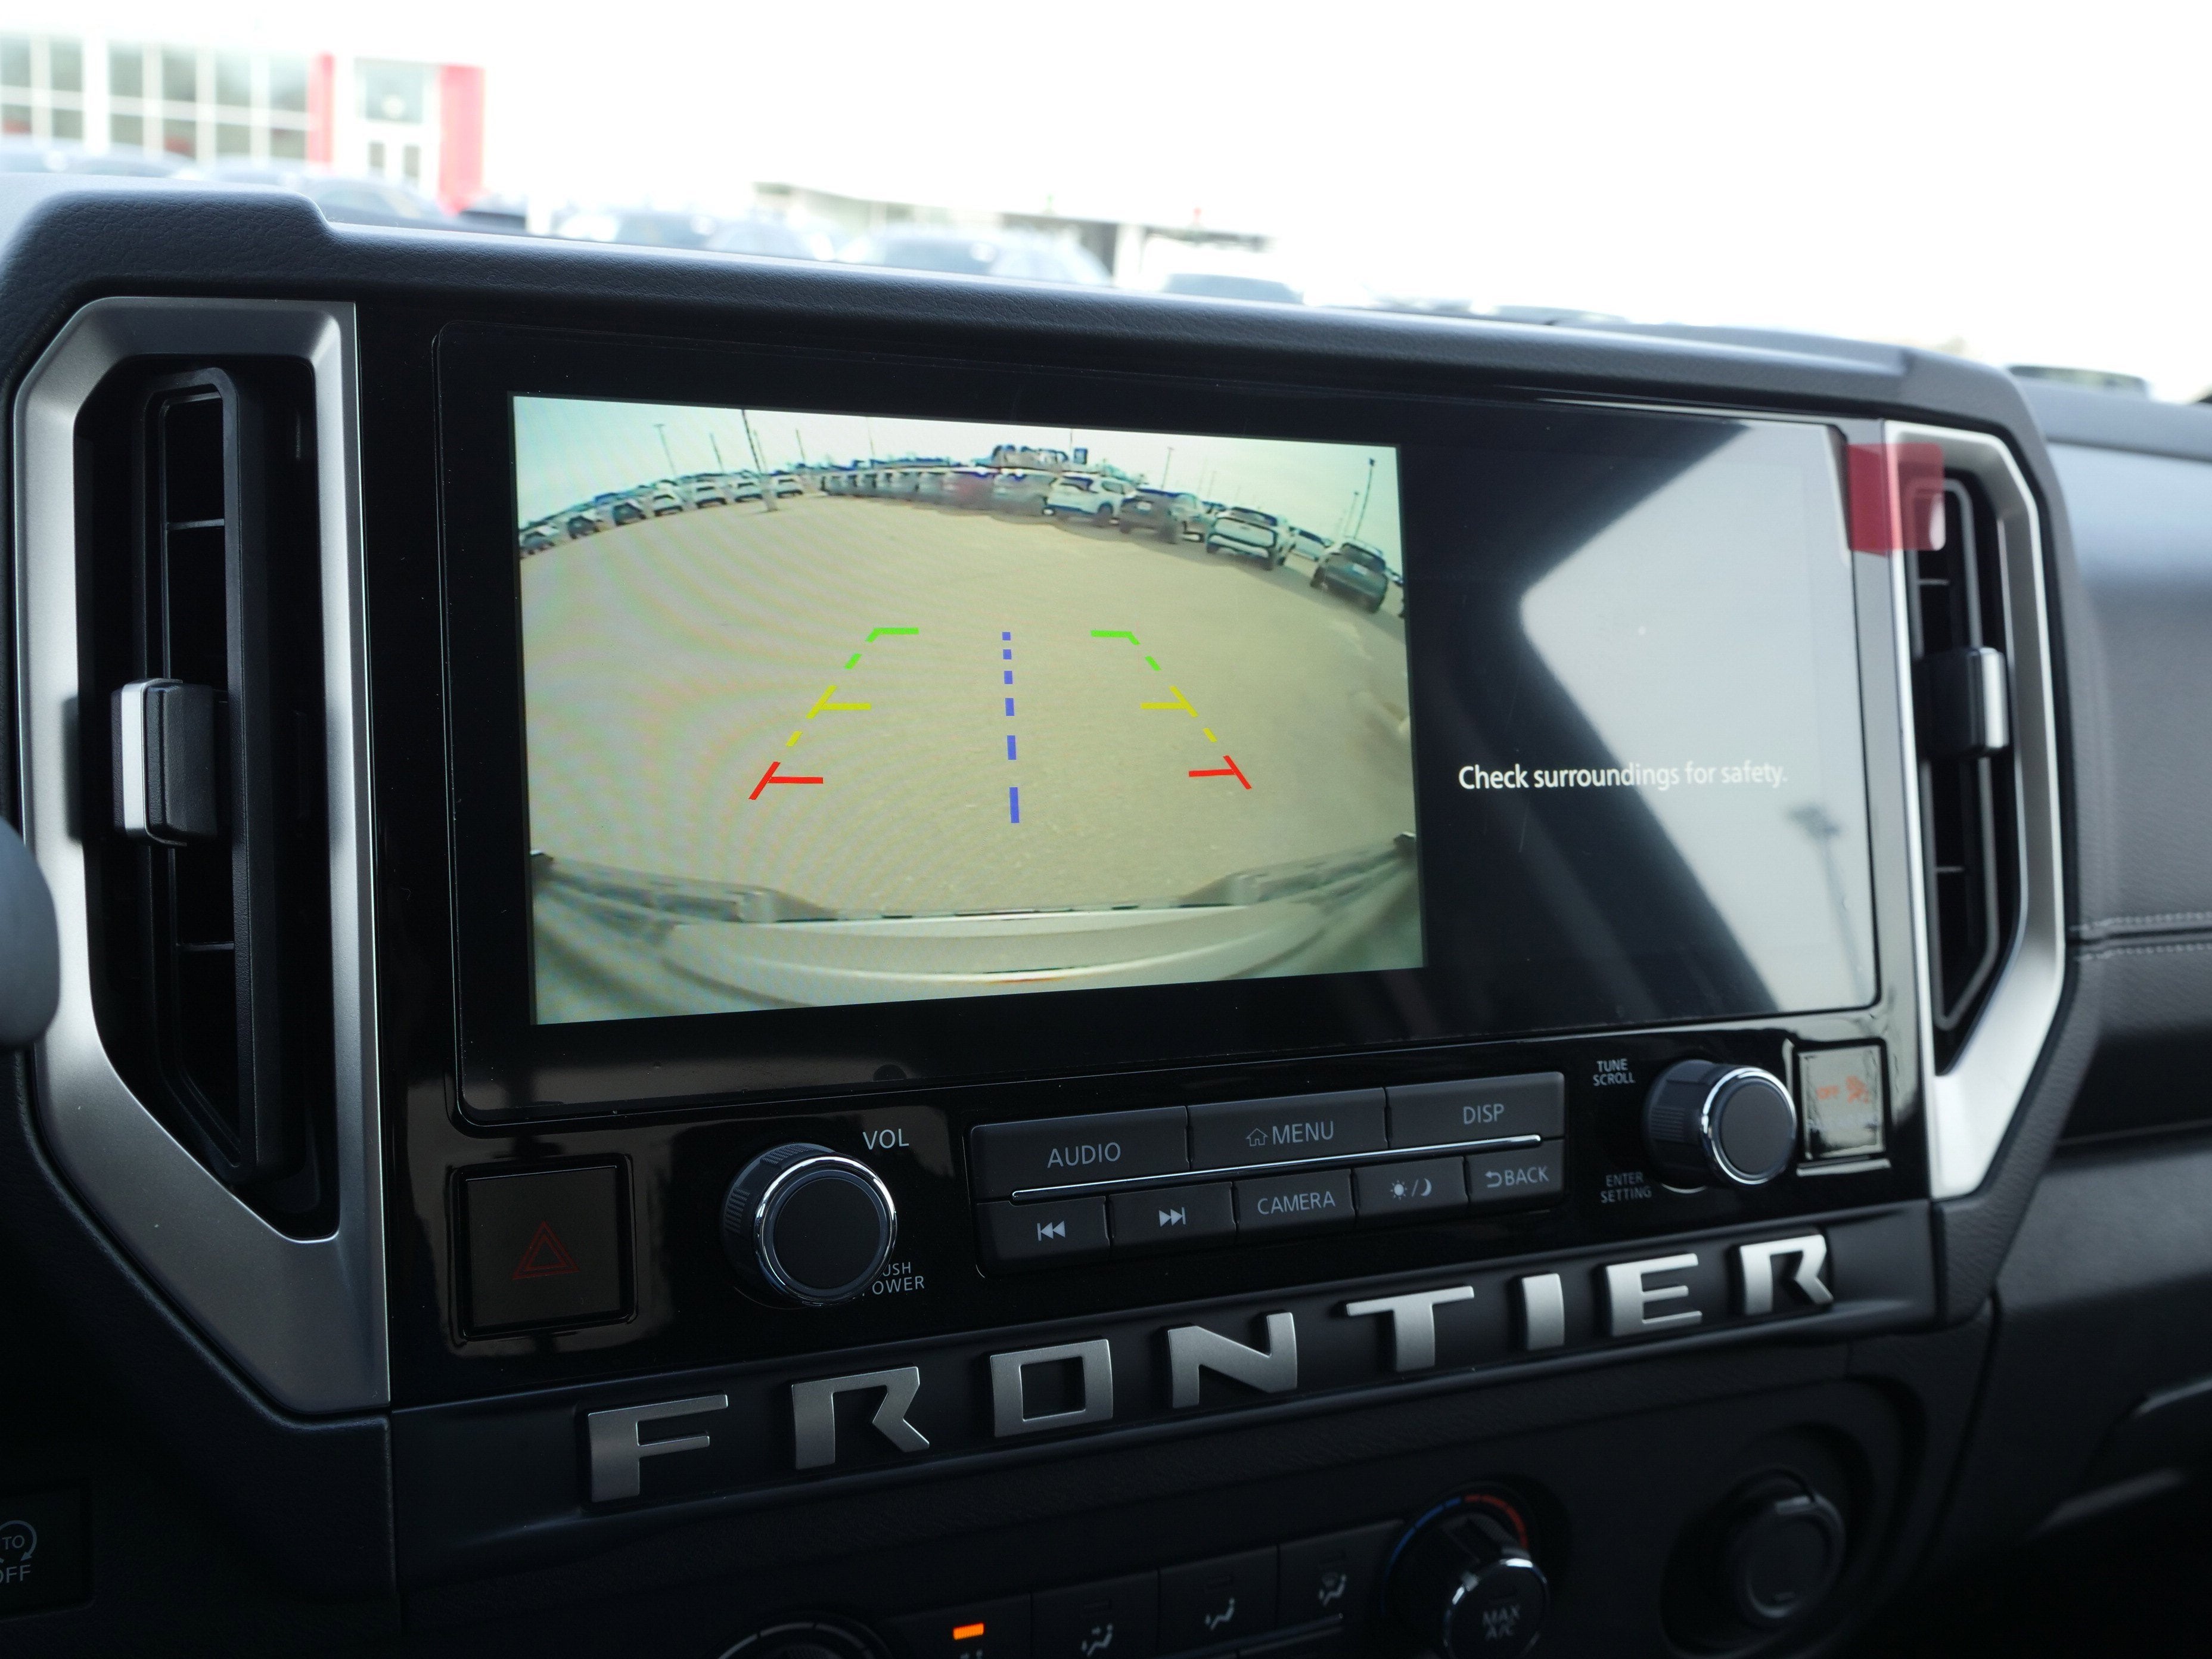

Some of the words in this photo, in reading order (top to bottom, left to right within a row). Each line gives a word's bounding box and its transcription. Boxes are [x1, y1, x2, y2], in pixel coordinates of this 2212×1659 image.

[1459, 763, 1529, 789] Check
[1533, 763, 1679, 790] surroundings
[1685, 760, 1716, 784] for
[1721, 759, 1789, 788] safety.
[1596, 1058, 1628, 1072] TUNE
[1593, 1072, 1635, 1087] SCROLL
[1463, 1104, 1505, 1124] DISP
[862, 1129, 909, 1150] VOL
[1272, 1120, 1335, 1145] MENU
[1047, 1142, 1121, 1169] AUDIO
[1505, 1166, 1549, 1187] BACK
[1605, 1171, 1644, 1187] ENTER
[1257, 1191, 1336, 1215] CAMERA
[1600, 1185, 1652, 1203] SETTING
[883, 1262, 911, 1276] USH
[862, 1275, 925, 1297] OWER
[587, 1232, 1834, 1502] FRONTIER
[2, 1535, 25, 1550] TO
[0, 1564, 31, 1583] FF
[1482, 1605, 1520, 1626] MAX
